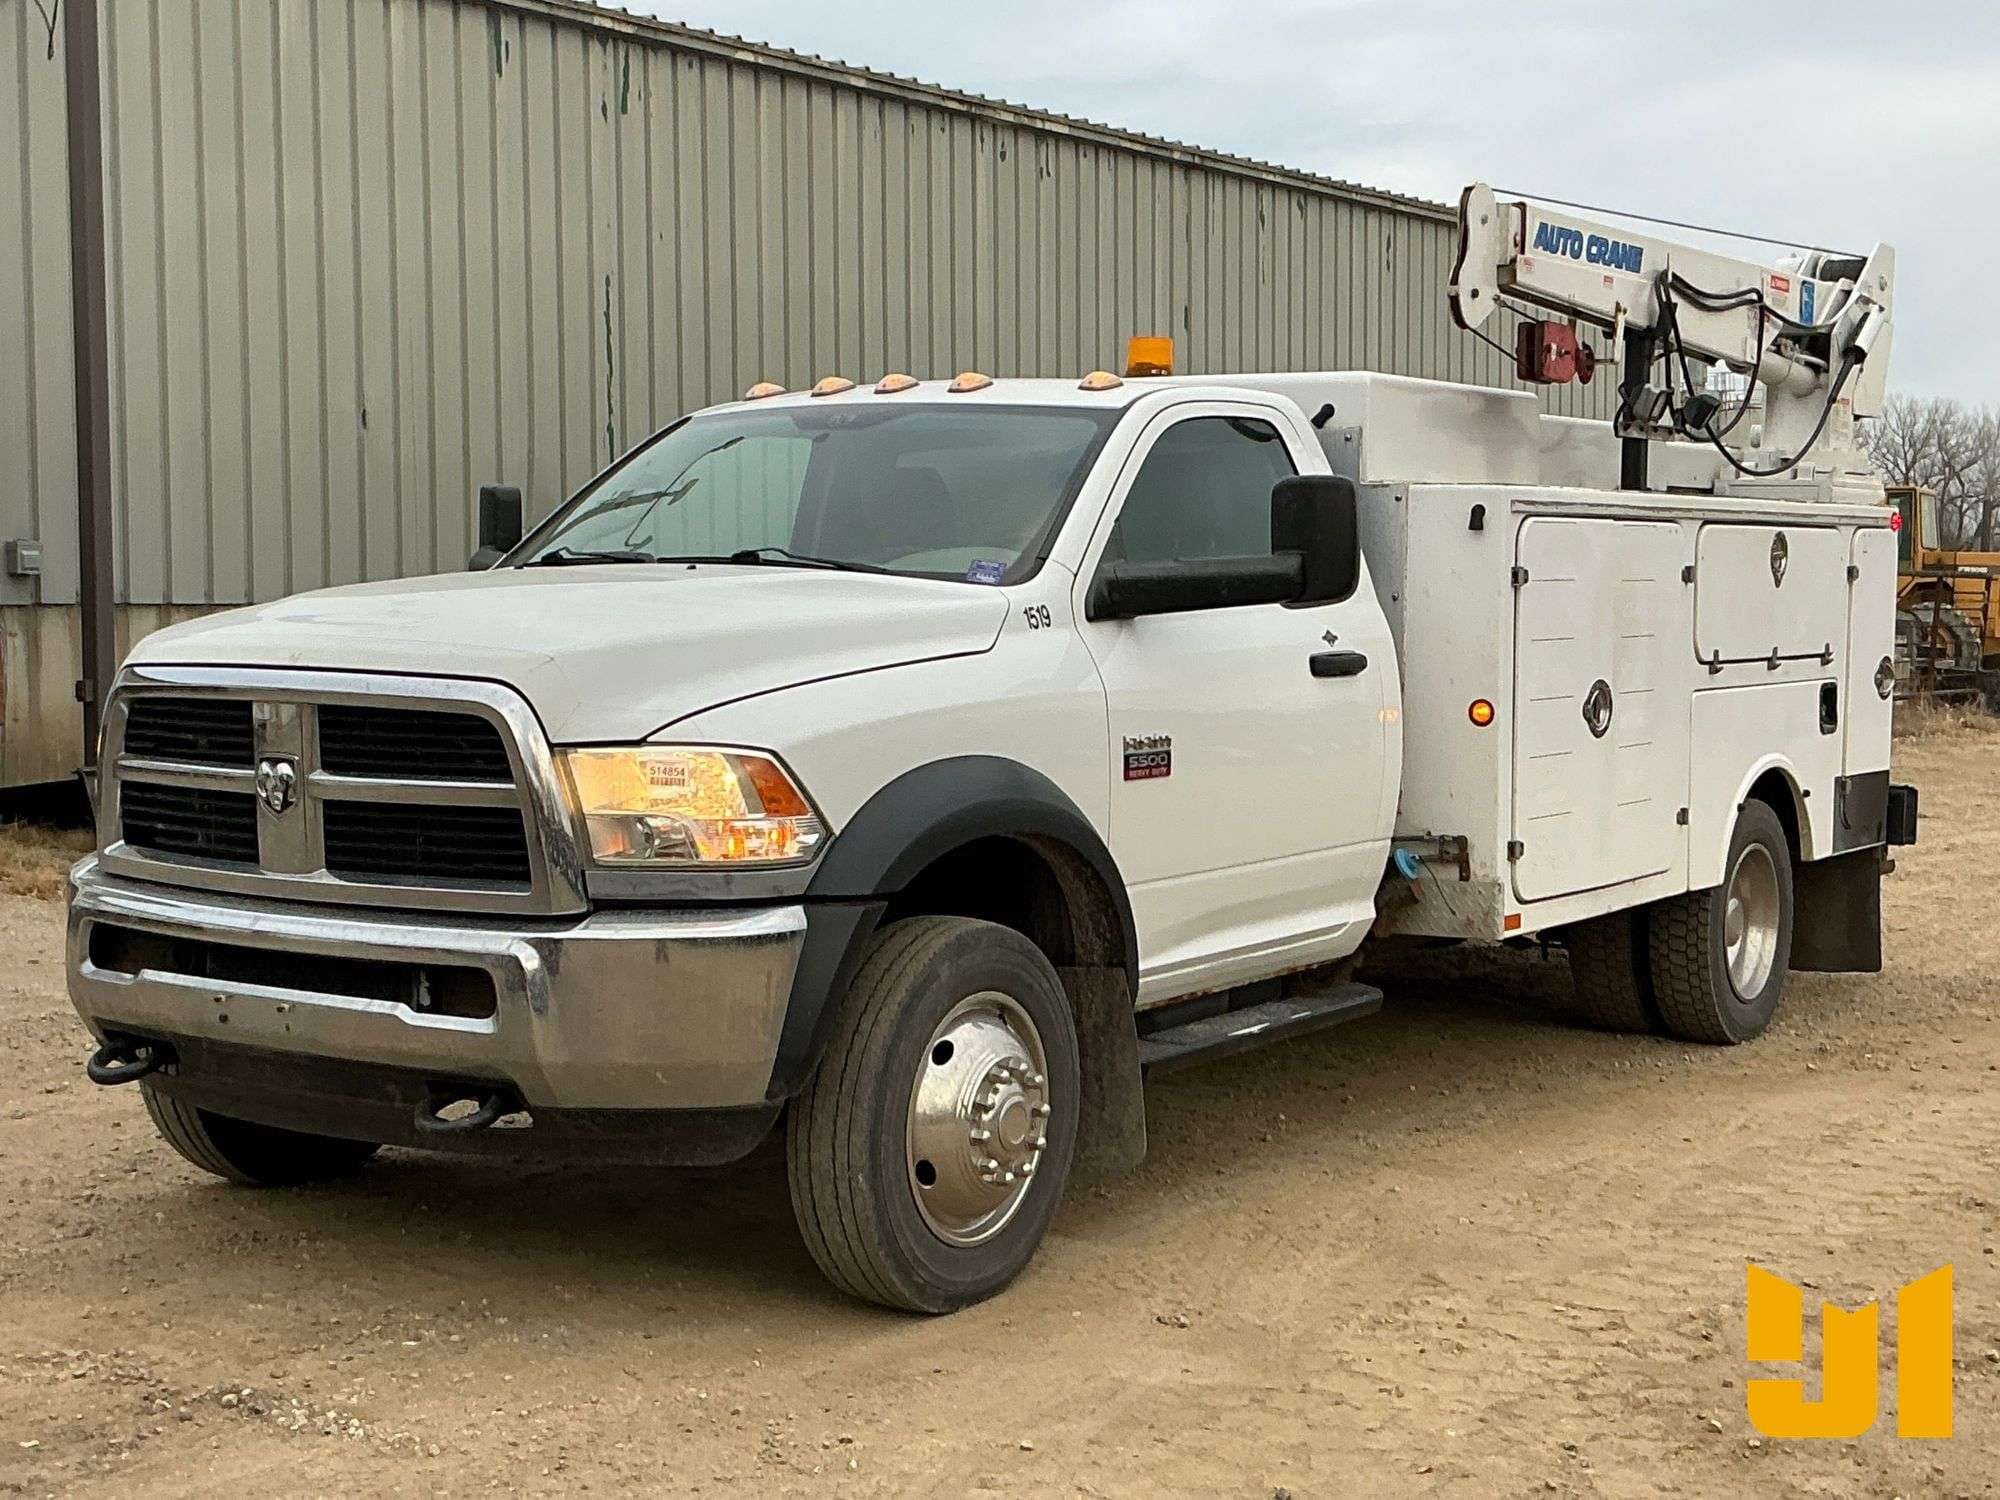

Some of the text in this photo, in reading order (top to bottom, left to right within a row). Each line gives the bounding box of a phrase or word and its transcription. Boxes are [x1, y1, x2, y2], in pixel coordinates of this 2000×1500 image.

[1533, 221, 1644, 274] AUTO CRANE
[1023, 604, 1052, 630] 1519
[1128, 753, 1168, 768] 5500
[650, 766, 685, 777] 514854
